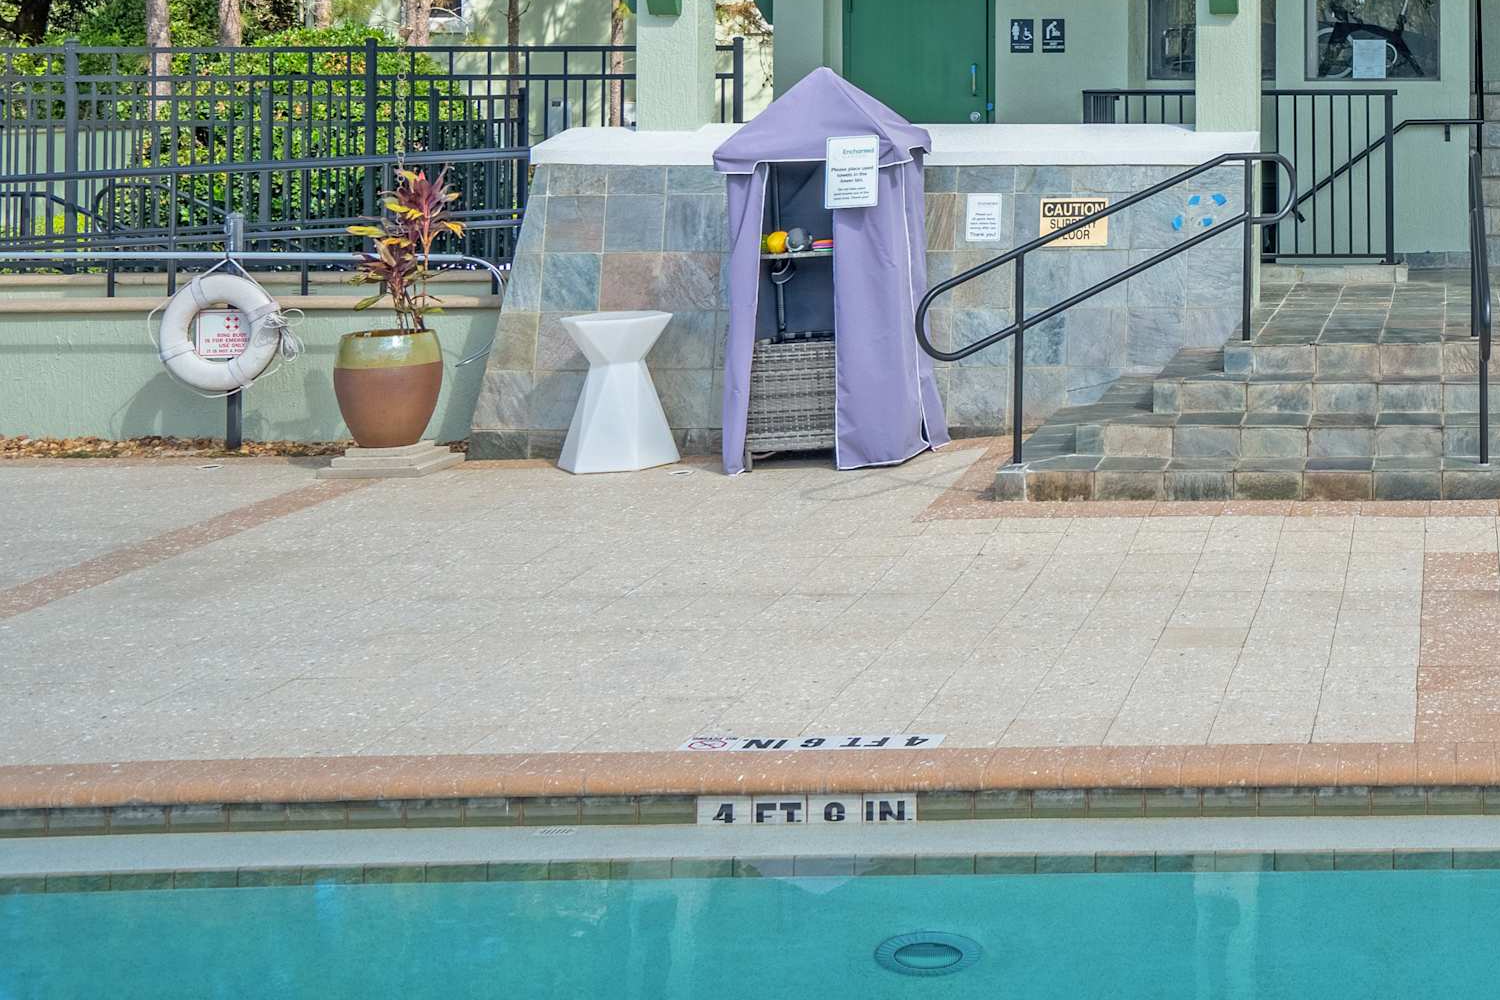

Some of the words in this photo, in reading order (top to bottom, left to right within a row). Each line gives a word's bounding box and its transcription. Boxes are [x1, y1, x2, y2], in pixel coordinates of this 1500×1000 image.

[1044, 203, 1104, 216] CAUTION
[800, 738, 826, 747] 6
[904, 736, 929, 747] 4
[712, 803, 736, 823] 4
[823, 802, 846, 821] 6
